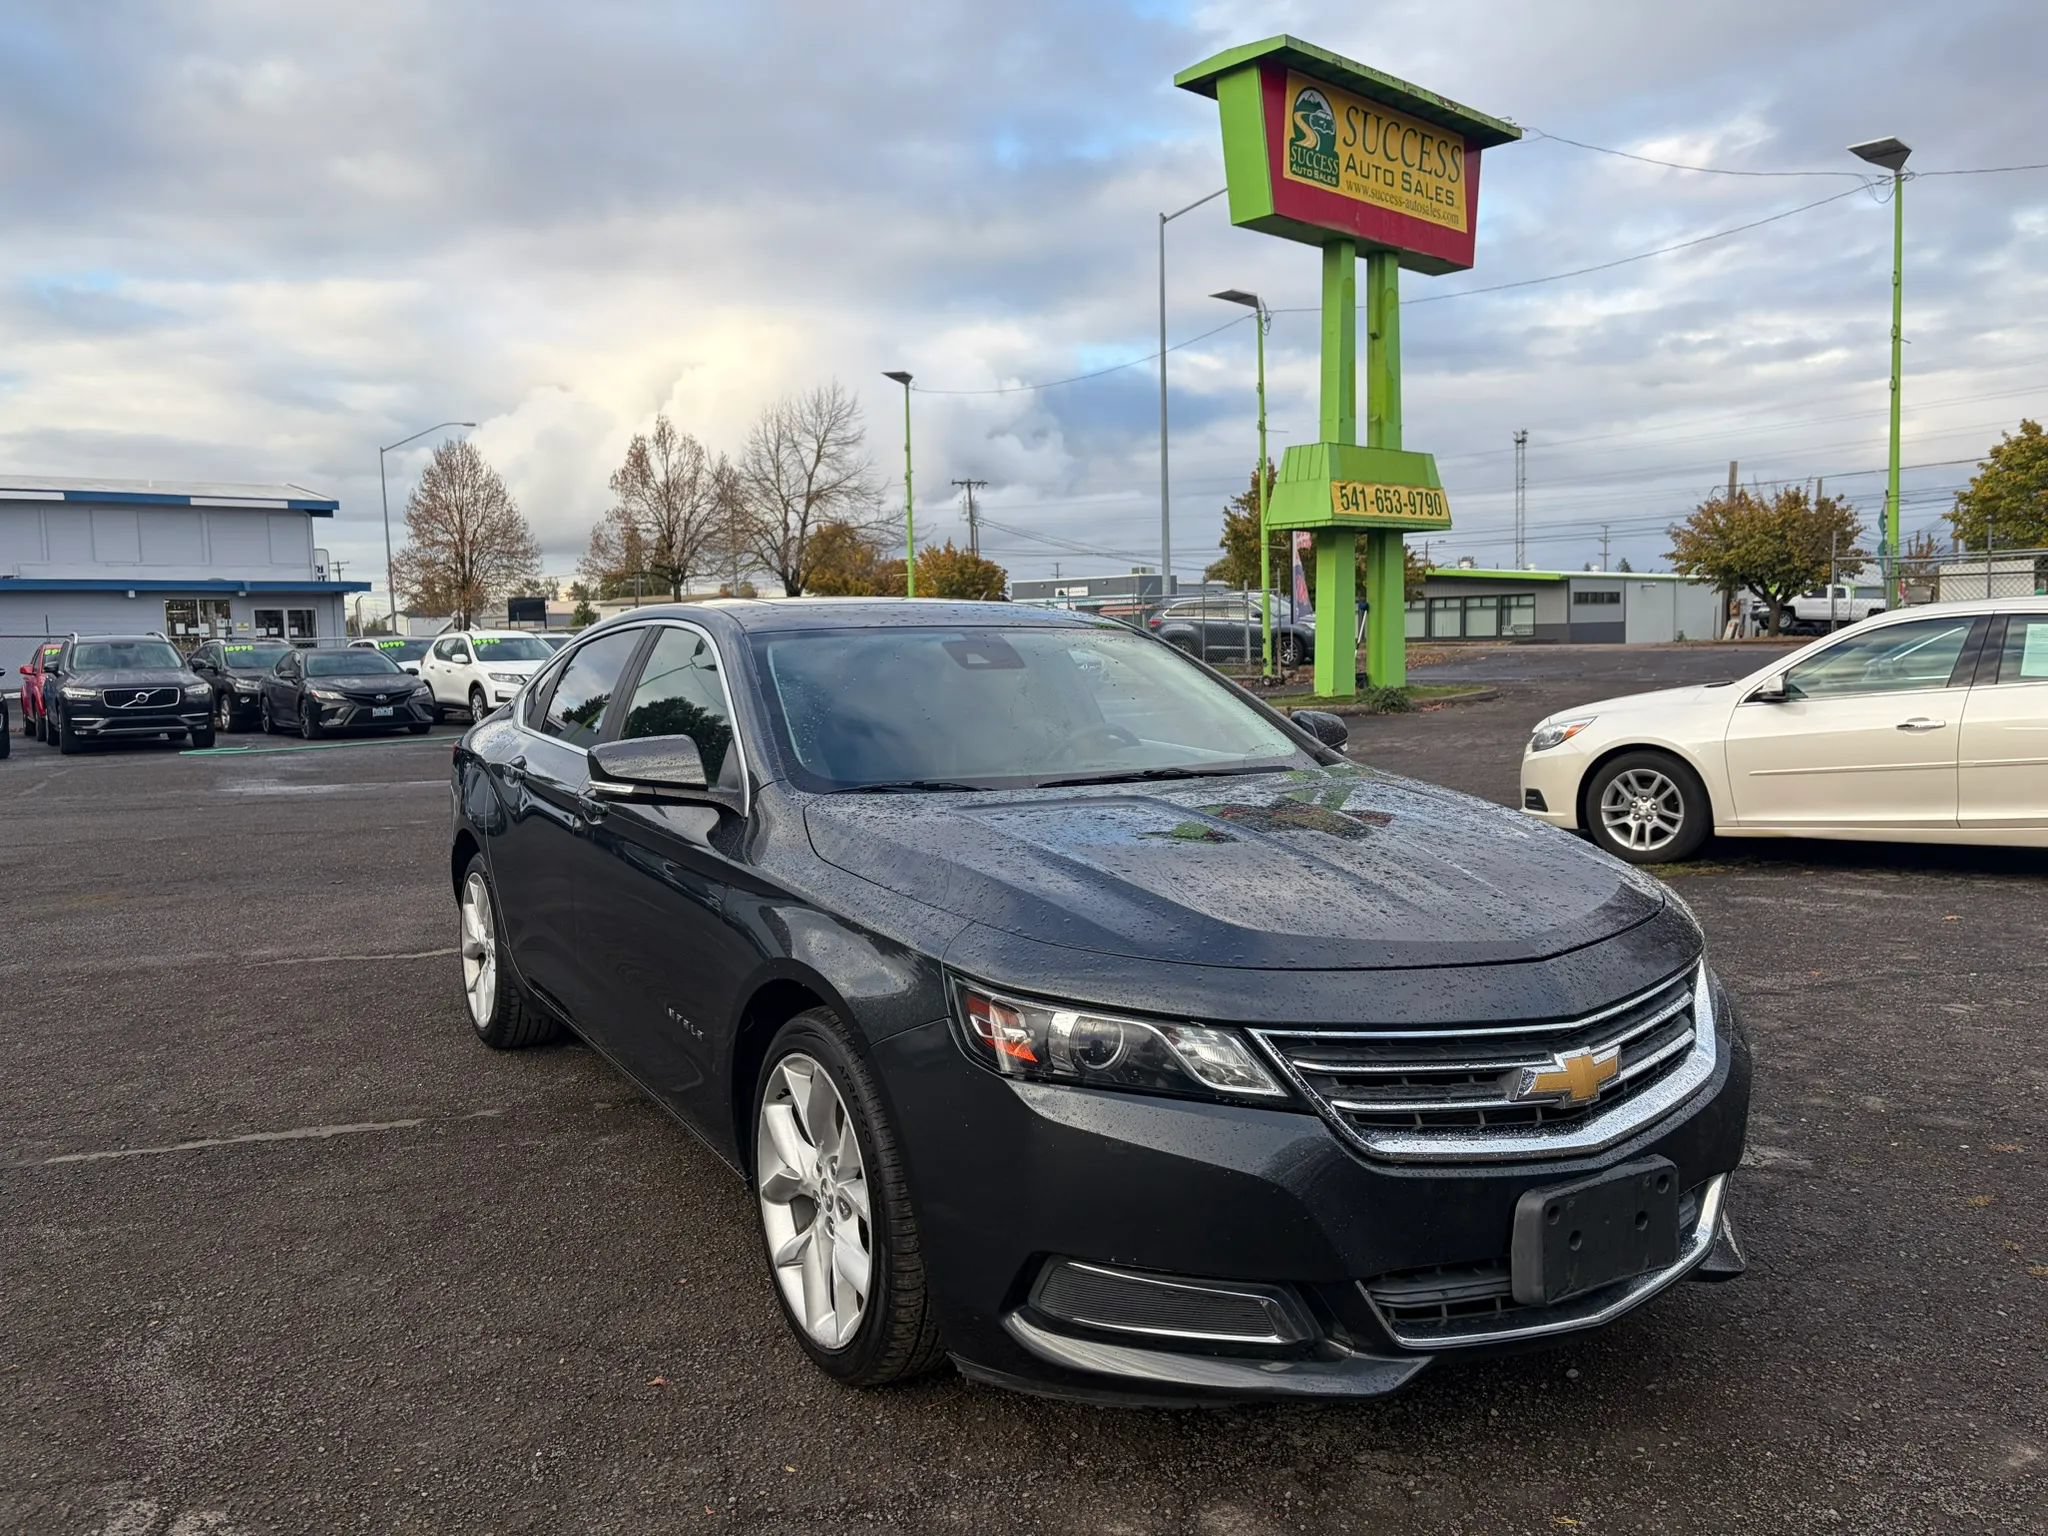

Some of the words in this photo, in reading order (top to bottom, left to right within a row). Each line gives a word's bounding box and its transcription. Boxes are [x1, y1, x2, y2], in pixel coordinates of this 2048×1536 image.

[1291, 146, 1338, 175] SUCCESS
[1343, 105, 1462, 183] SUCCESS
[1292, 164, 1313, 177] AUTO
[1313, 170, 1337, 184] SALES
[1345, 153, 1394, 187] AUTO
[1401, 171, 1455, 207] SALES
[1345, 180, 1459, 224] www.success-autosales.com
[1340, 486, 1442, 516] 541-653-9790
